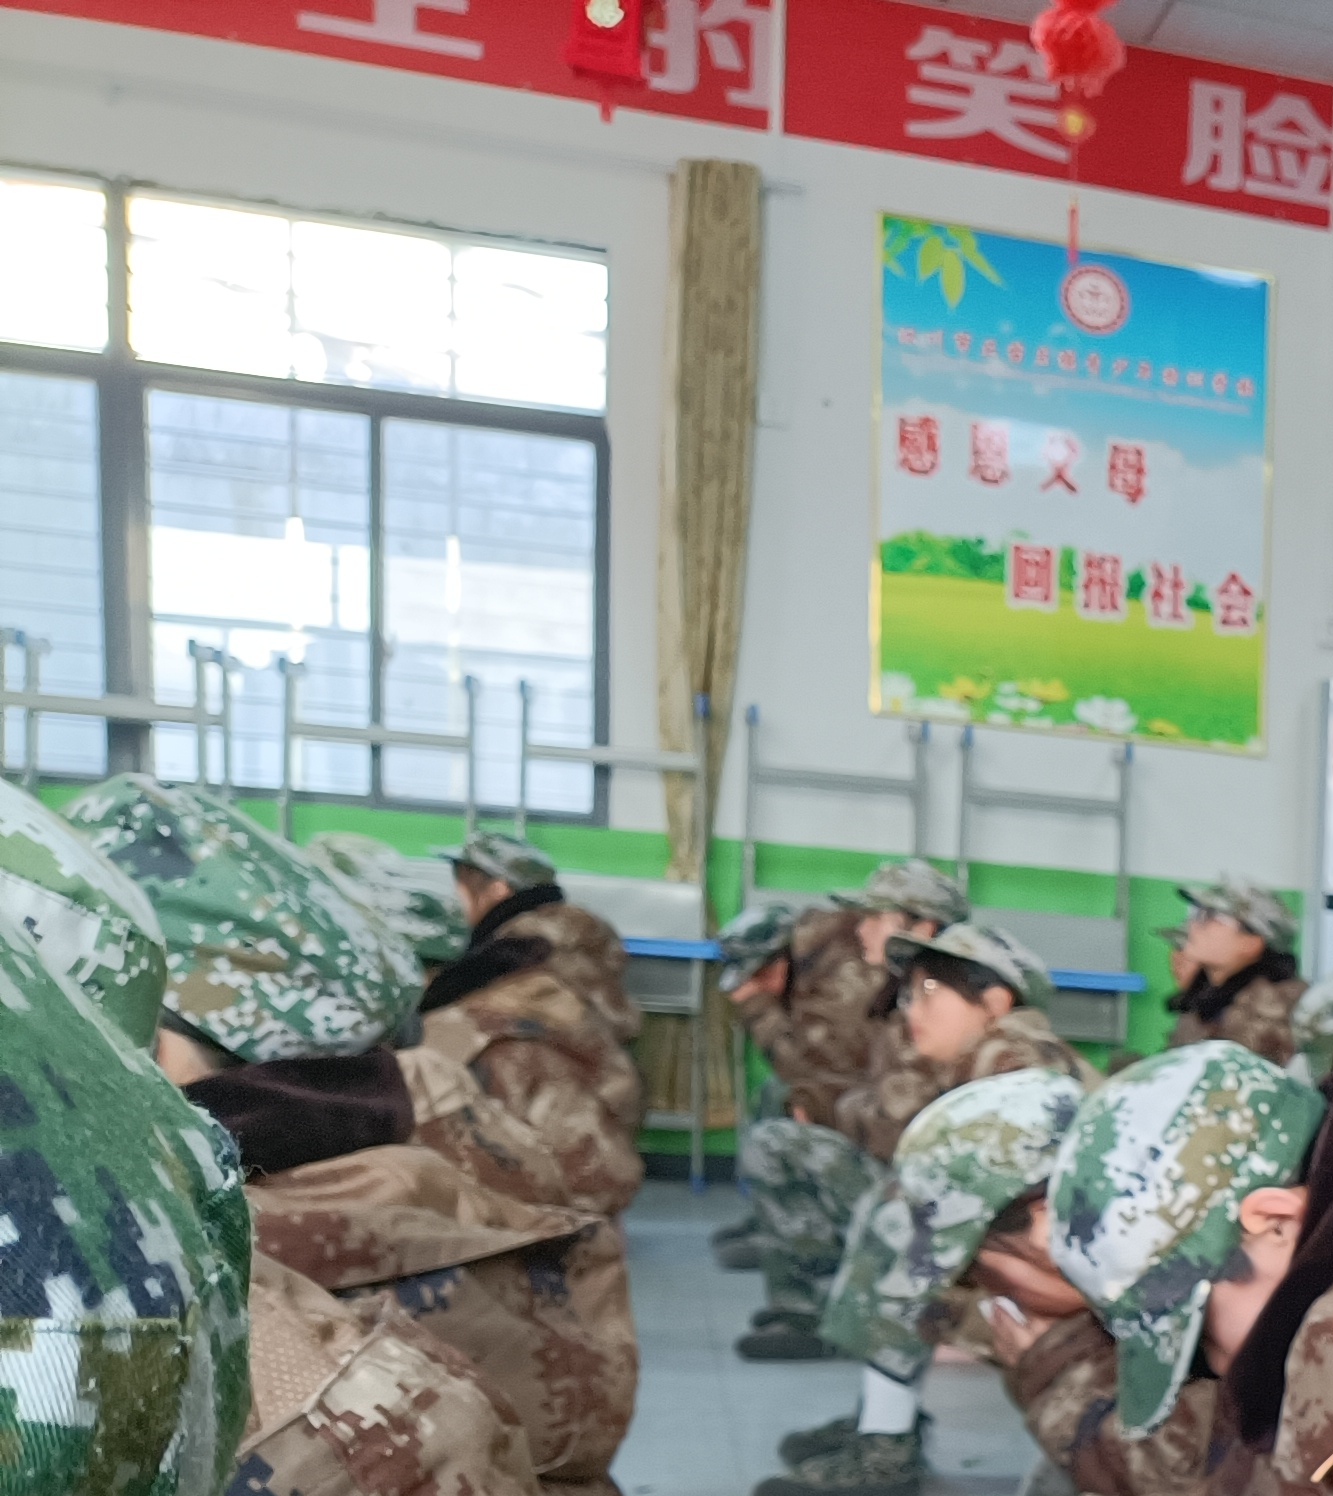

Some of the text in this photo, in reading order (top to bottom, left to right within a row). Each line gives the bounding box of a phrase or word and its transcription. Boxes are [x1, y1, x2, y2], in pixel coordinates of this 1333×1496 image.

[897, 415, 1147, 504] 感恩父母
[1012, 545, 1254, 628] 回报社会
